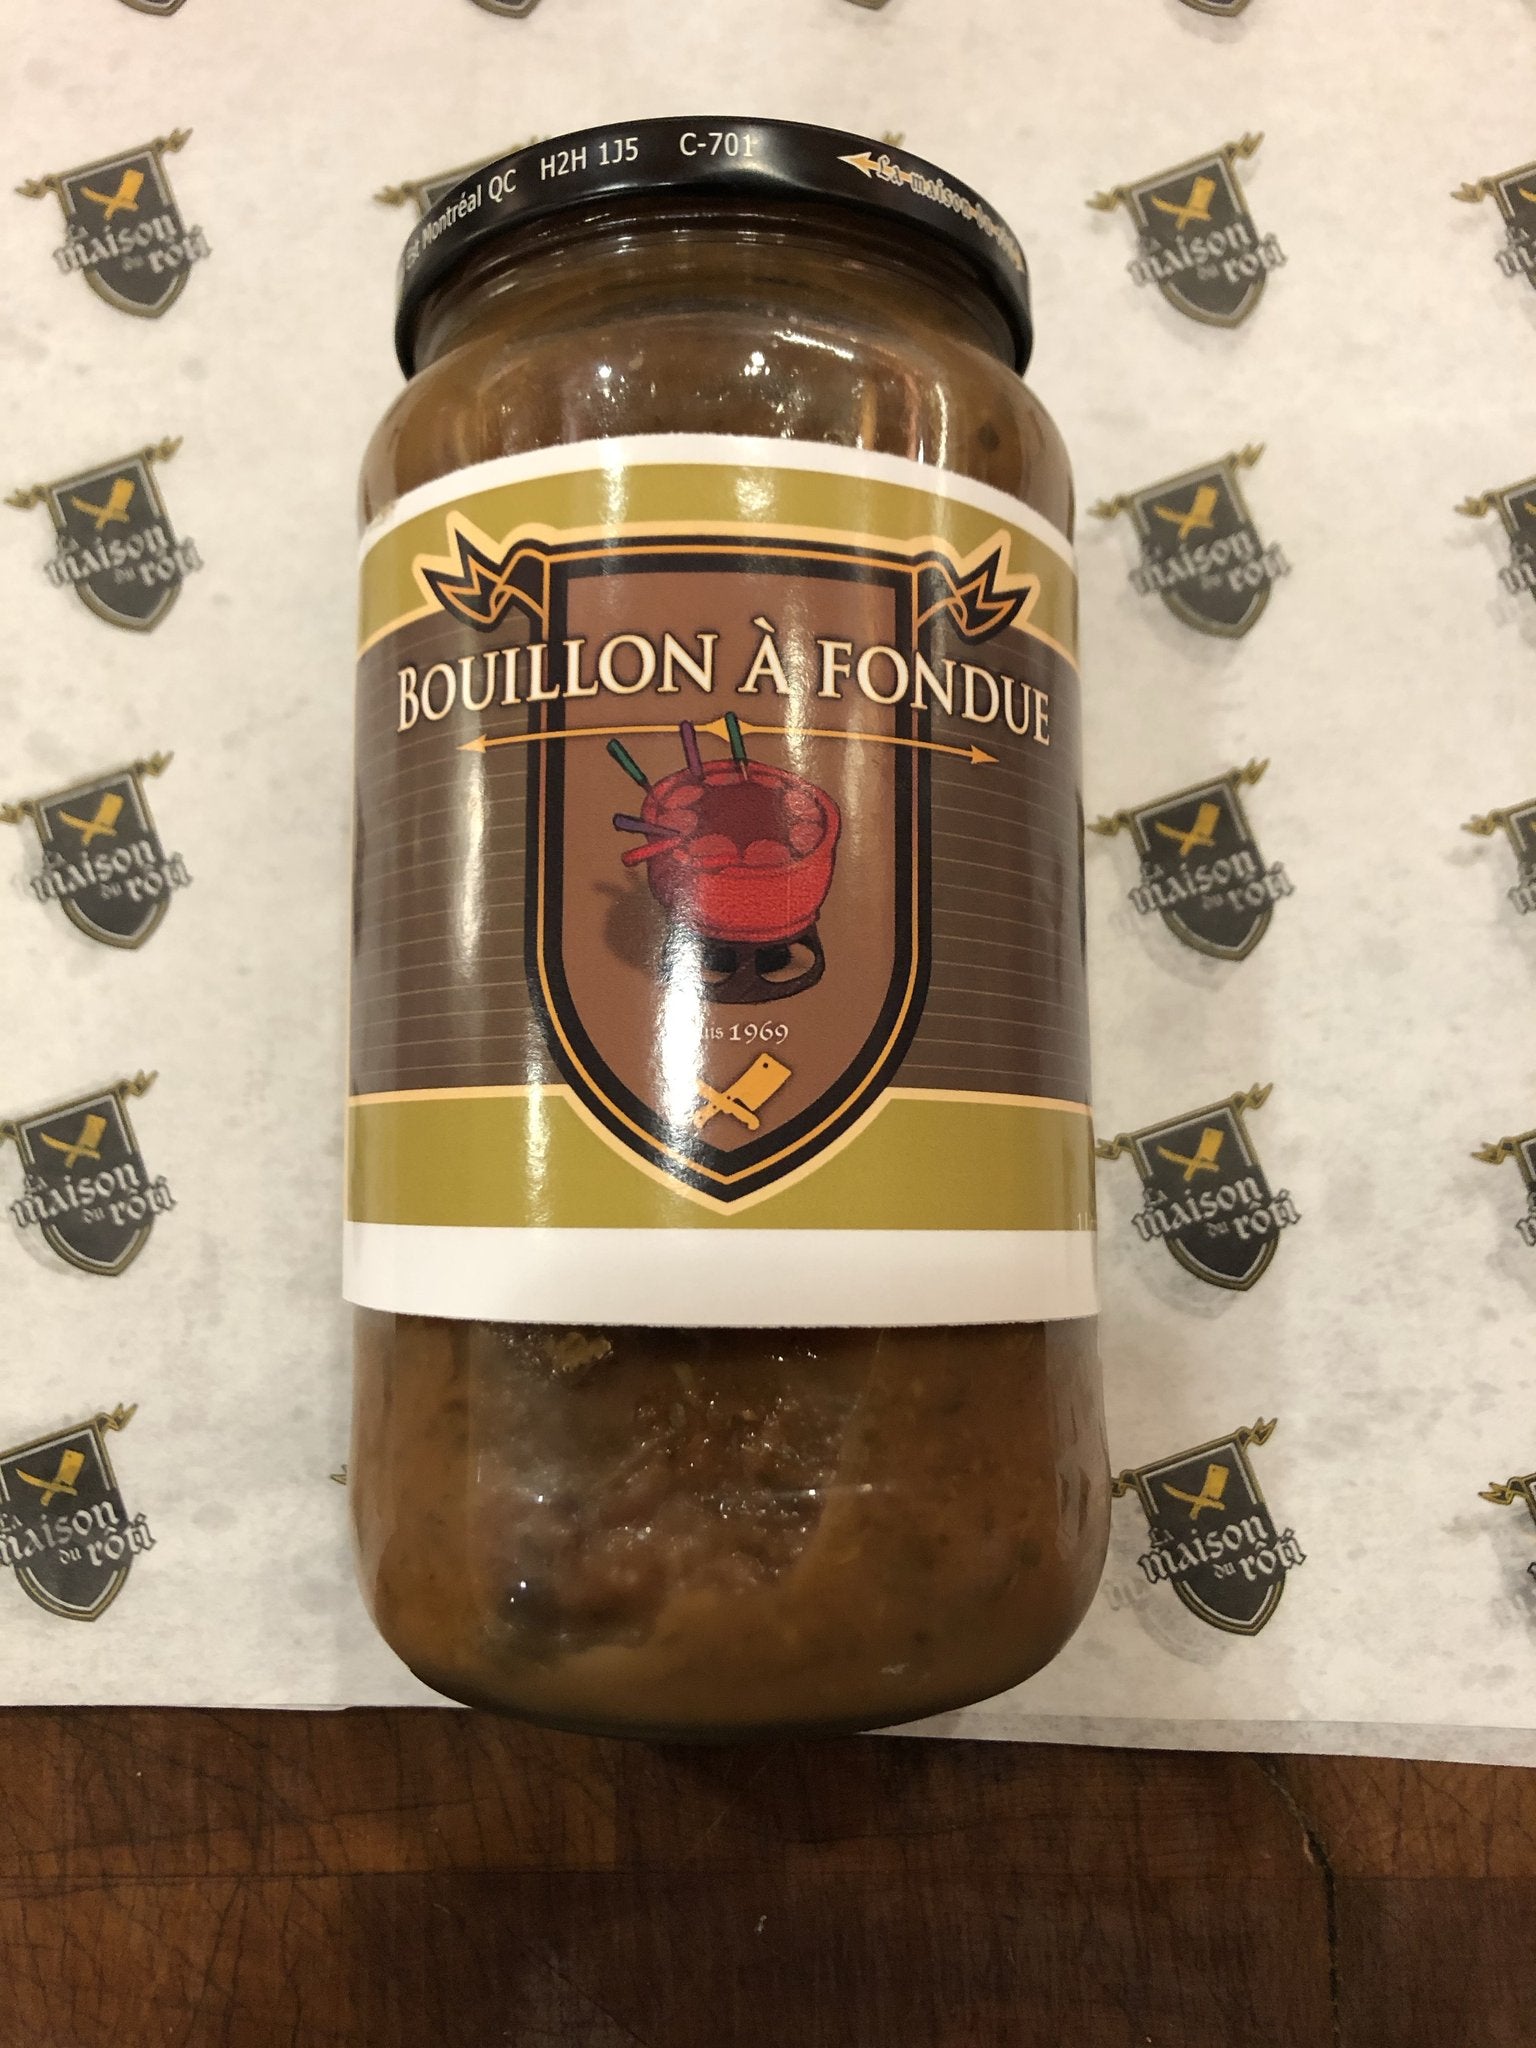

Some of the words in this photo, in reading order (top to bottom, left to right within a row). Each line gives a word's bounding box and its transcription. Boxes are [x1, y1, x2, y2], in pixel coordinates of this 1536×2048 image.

[421, 183, 482, 251] Montréal
[488, 168, 517, 203] QC
[540, 146, 587, 181] H2H
[599, 137, 639, 166] 1J5
[679, 132, 754, 157] C-701
[910, 171, 972, 220] maison
[397, 632, 719, 733] BOUILLON
[738, 617, 791, 698] À
[816, 639, 1050, 747] FONDUE
[729, 1020, 789, 1045] 1969
[10, 1163, 140, 1227] maison
[1132, 1177, 1263, 1241] maison
[1137, 1515, 1268, 1583] maison
